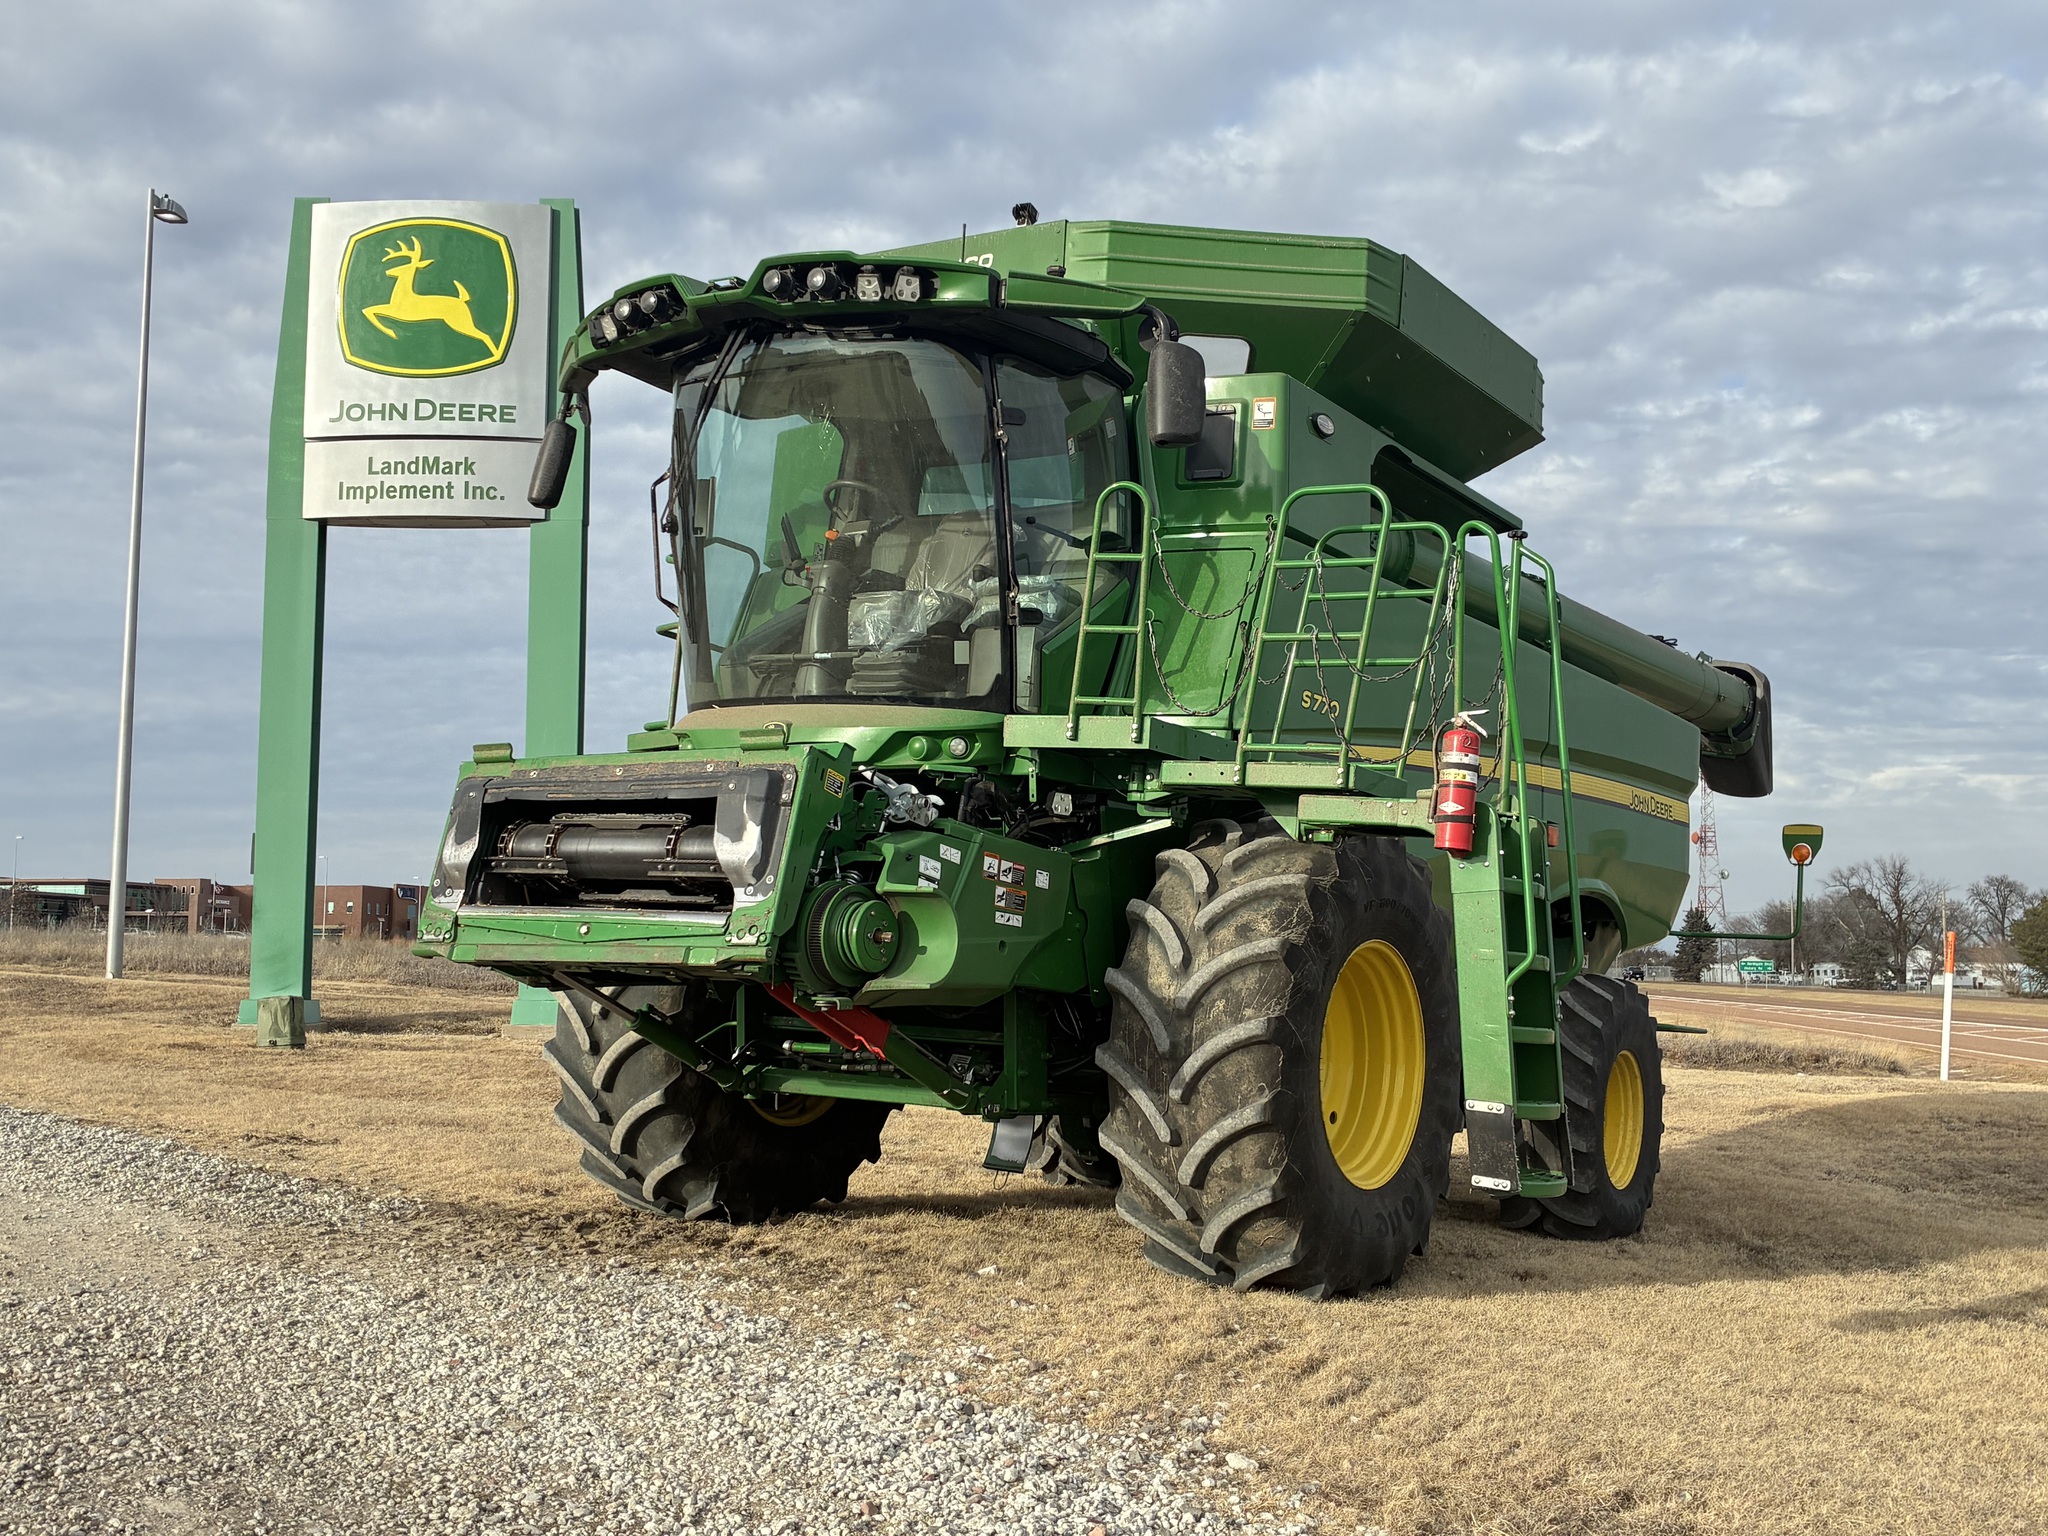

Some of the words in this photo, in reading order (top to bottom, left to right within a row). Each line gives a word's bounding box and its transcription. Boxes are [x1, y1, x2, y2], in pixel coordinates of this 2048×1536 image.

[329, 400, 408, 423] JOHN
[414, 399, 517, 423] DEERE
[367, 456, 476, 476] LandMark
[338, 480, 455, 504] Implement
[464, 481, 505, 501] Inc.
[1630, 790, 1650, 814] JOHN
[1650, 796, 1674, 819] DEERE
